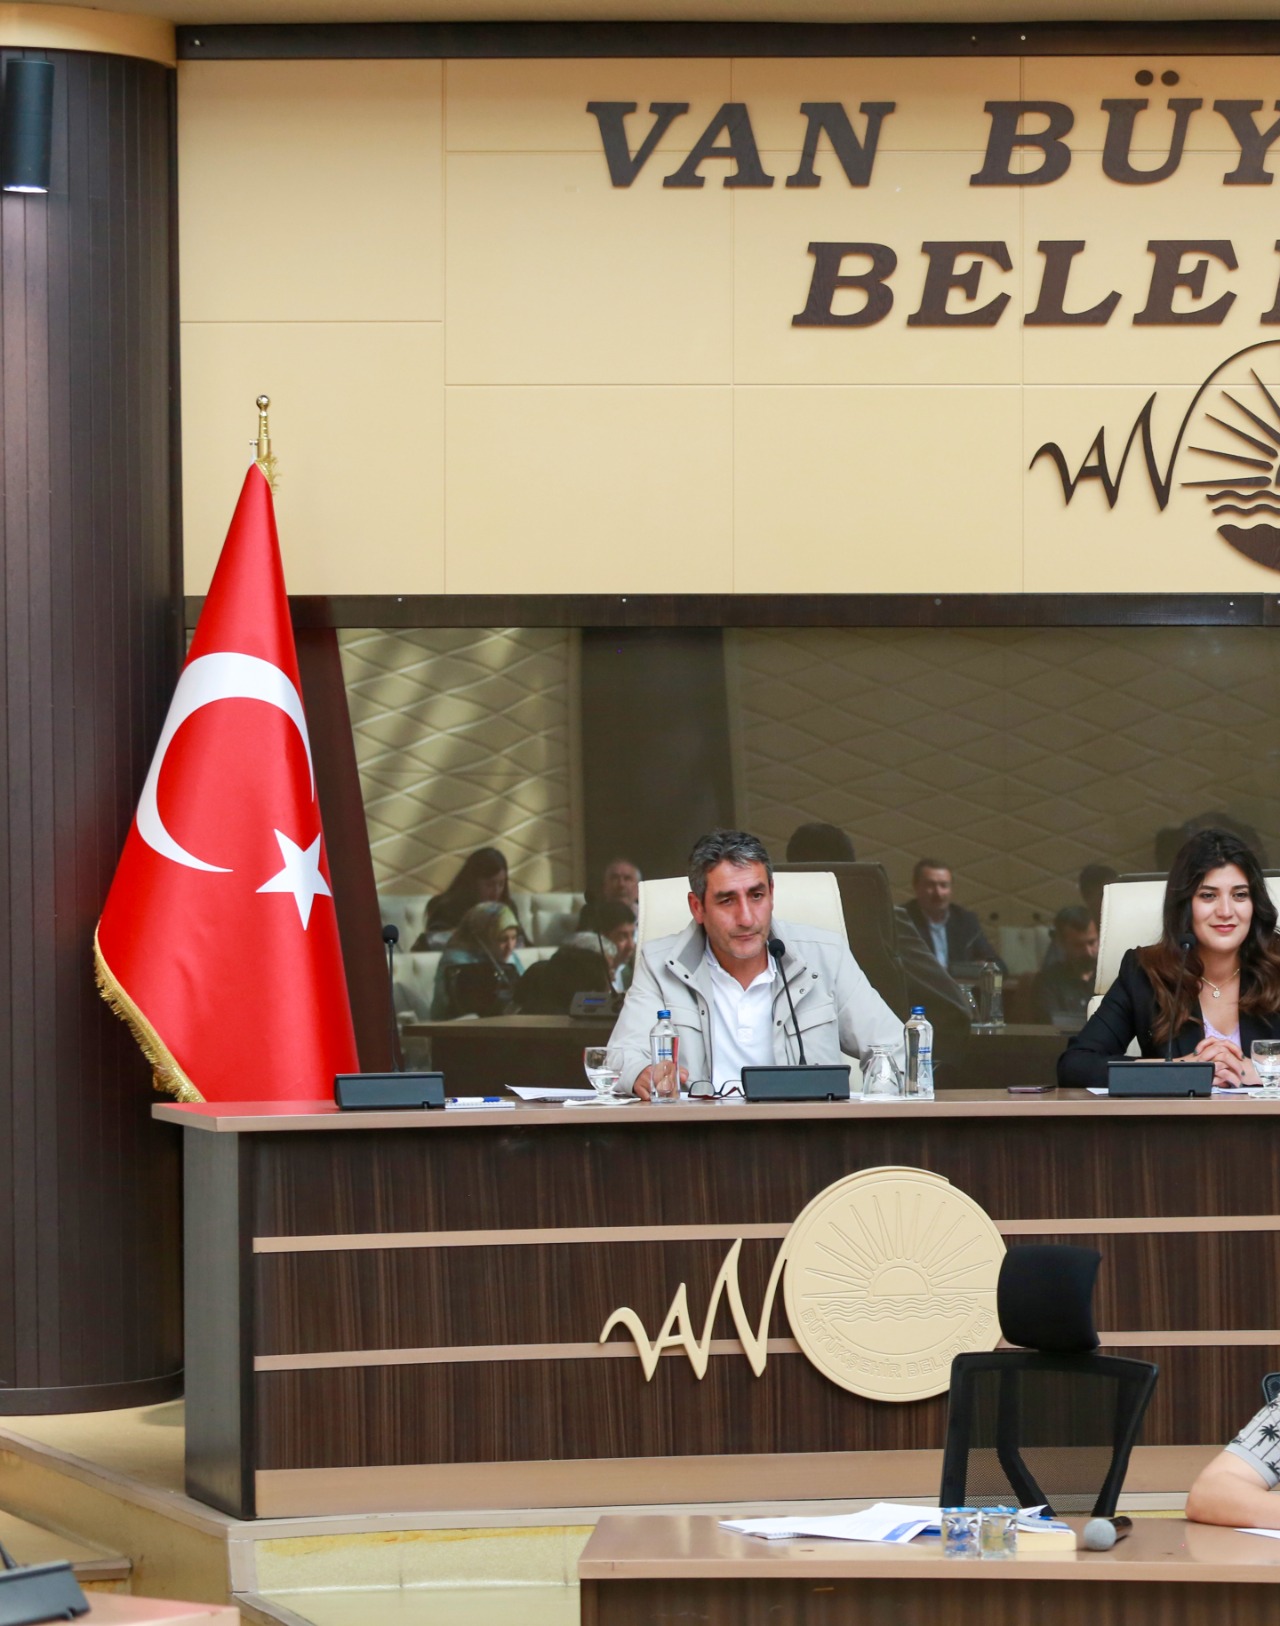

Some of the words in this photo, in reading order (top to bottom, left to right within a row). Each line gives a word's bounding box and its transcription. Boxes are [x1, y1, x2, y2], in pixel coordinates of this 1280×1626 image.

[586, 100, 897, 188] VAN
[800, 1307, 901, 1378] BÜYÜKŞEHİR
[906, 1305, 996, 1377] BELEDİYESİ
